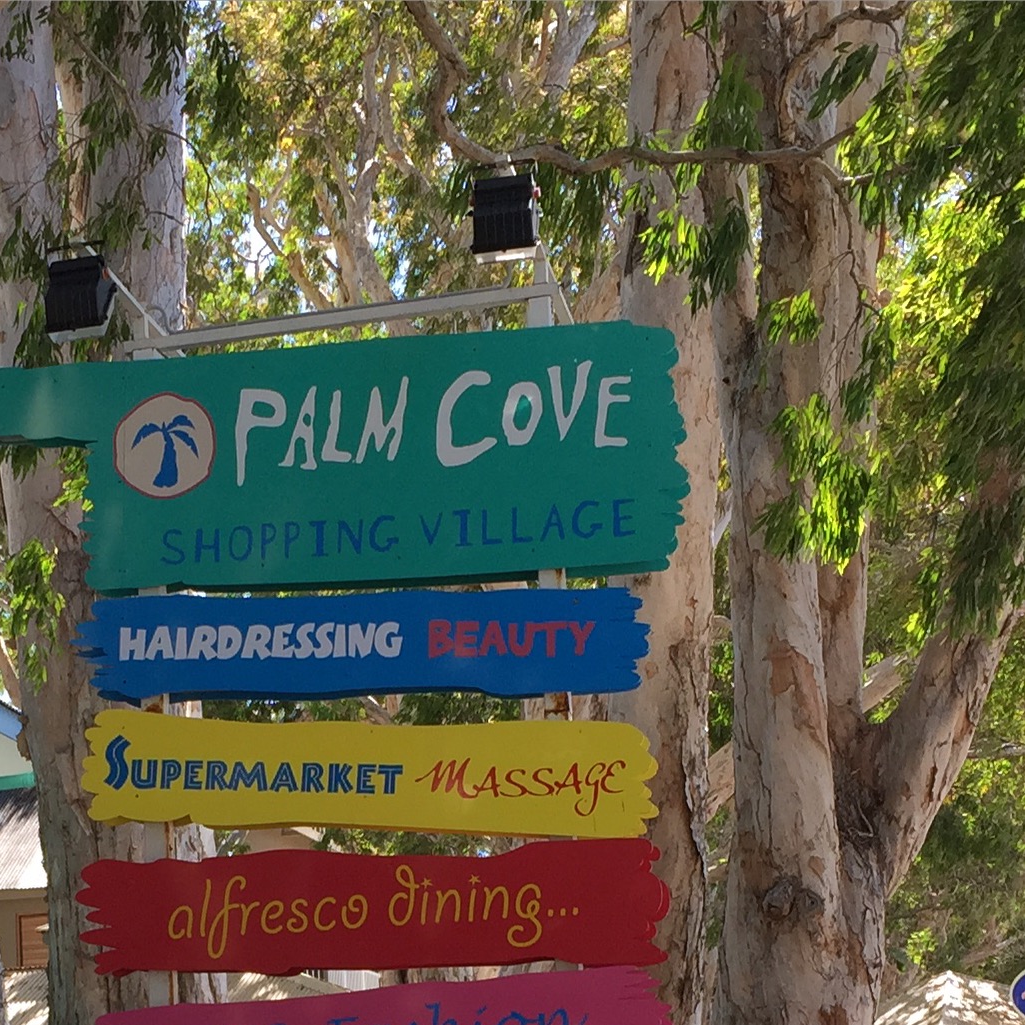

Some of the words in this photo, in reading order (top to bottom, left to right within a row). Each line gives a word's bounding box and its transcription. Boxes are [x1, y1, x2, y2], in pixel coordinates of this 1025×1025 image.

[236, 376, 409, 486] PALM
[437, 360, 631, 467] COVE
[161, 515, 398, 567] SHOPPING
[421, 499, 636, 548] VILLAGE
[118, 621, 403, 661] HAIRDRESSING
[428, 619, 595, 658] BEAUTY
[168, 875, 368, 959] alfresco
[388, 865, 579, 948] dining...
